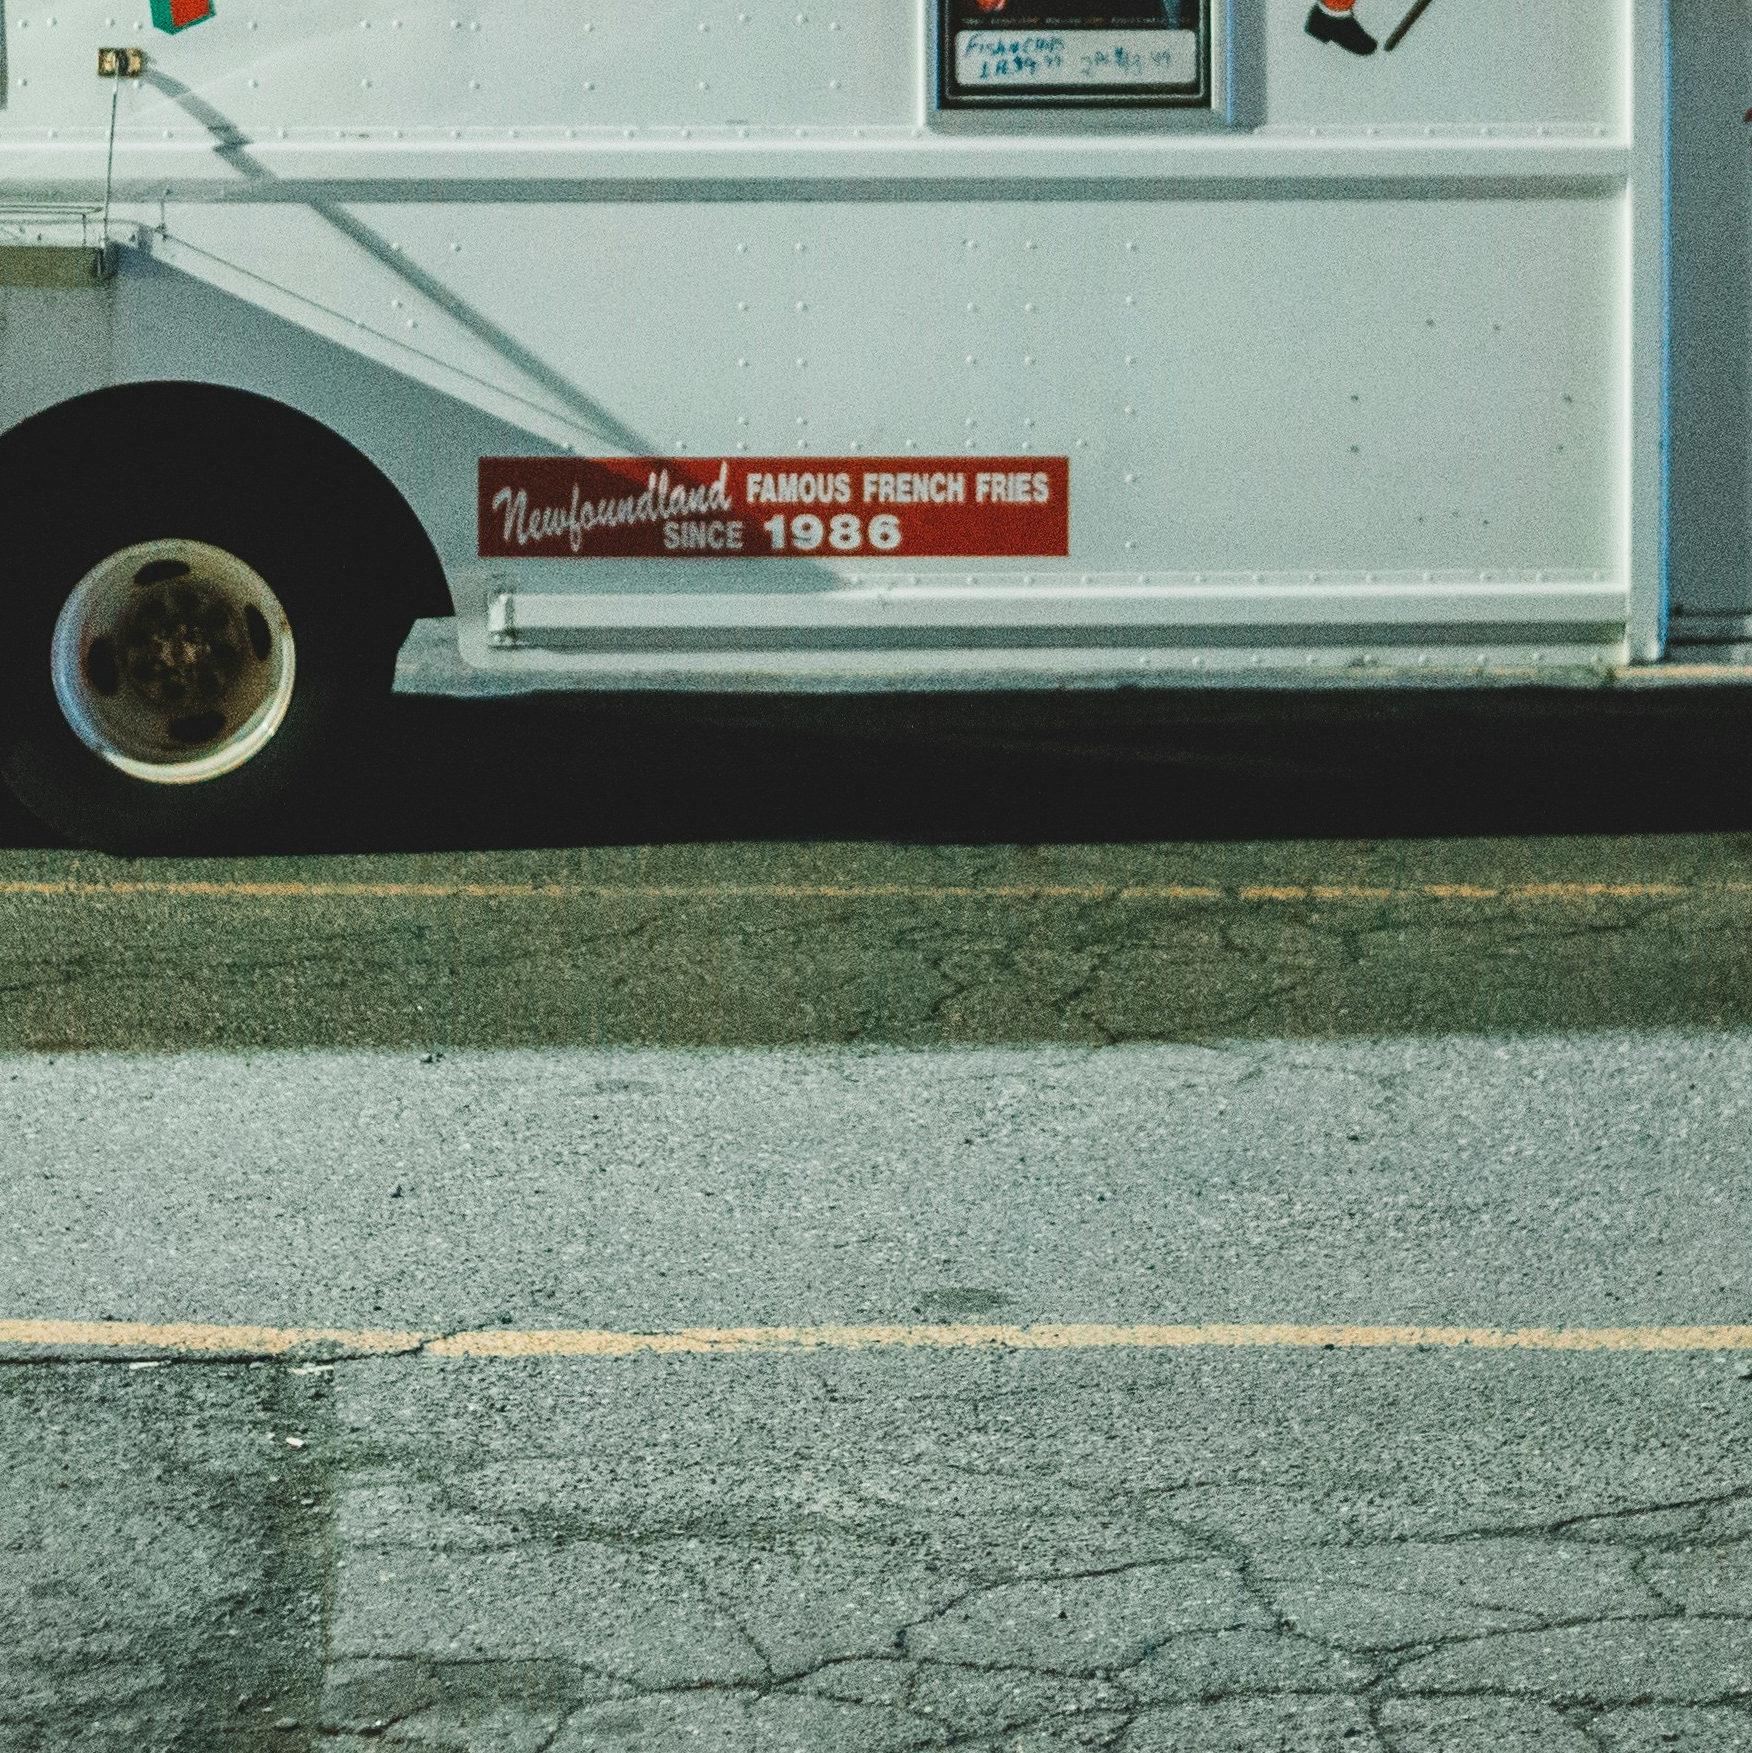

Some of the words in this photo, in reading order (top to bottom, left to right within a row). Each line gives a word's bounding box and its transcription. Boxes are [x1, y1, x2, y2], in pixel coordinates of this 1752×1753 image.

[491, 460, 733, 554] Newfoundland
[746, 472, 852, 504] FAMOUS
[863, 472, 965, 504] FRENCH
[975, 472, 1051, 504] FRIES
[662, 520, 745, 550] SINCE
[763, 513, 904, 551] 1986
